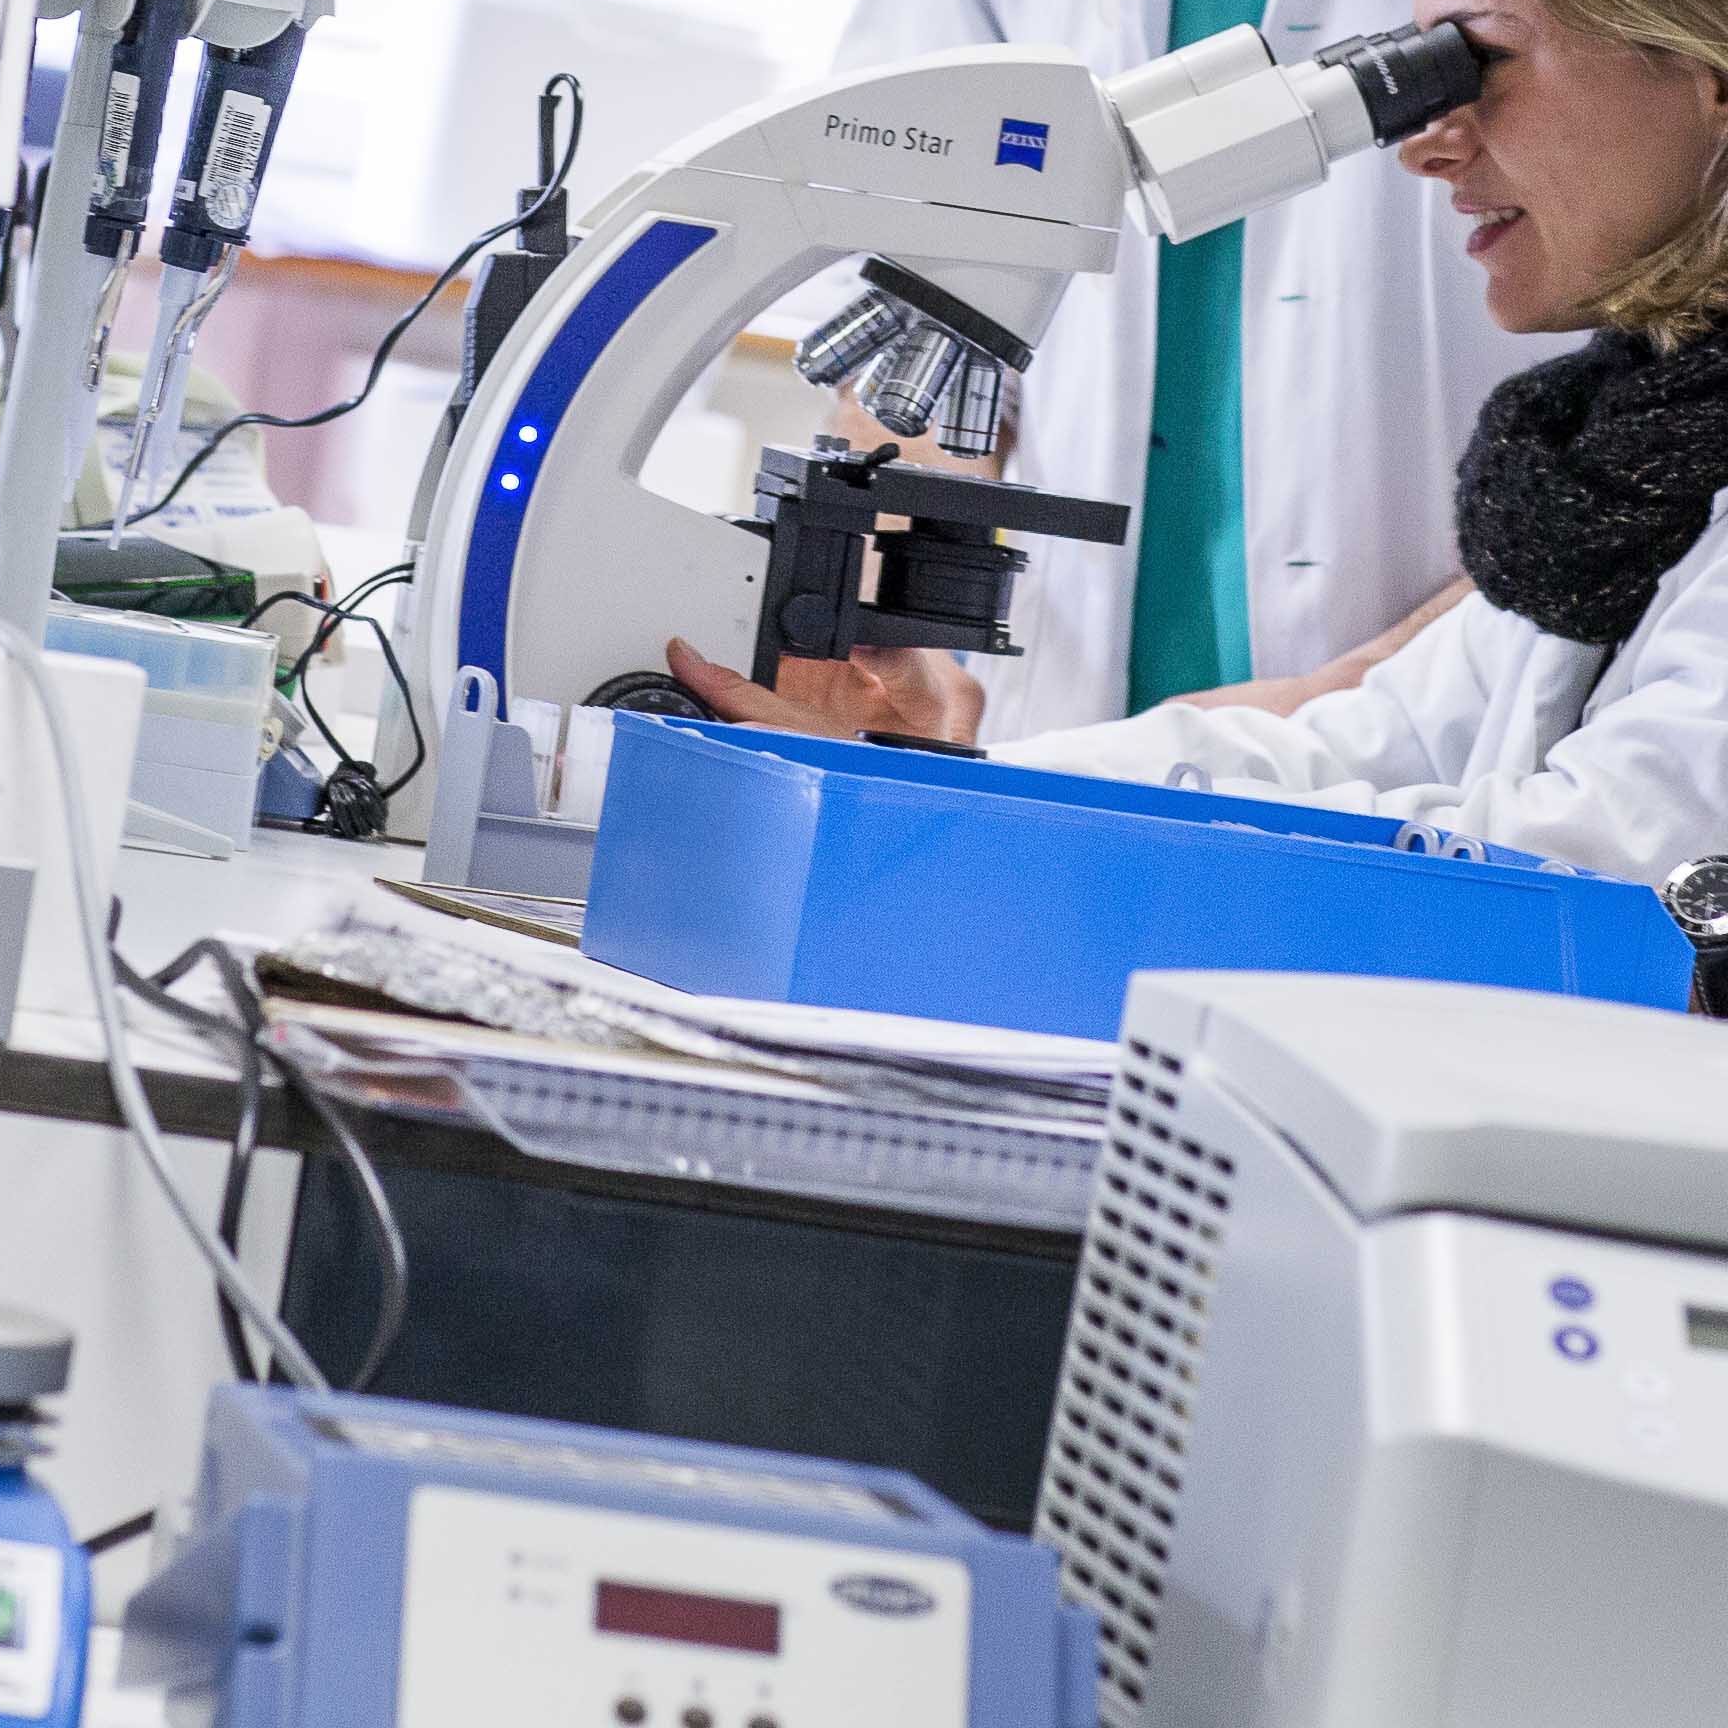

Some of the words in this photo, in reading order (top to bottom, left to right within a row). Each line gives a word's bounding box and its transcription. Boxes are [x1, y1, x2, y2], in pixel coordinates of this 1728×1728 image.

[824, 113, 897, 147] Primo
[903, 127, 954, 156] Star
[1000, 132, 1048, 150] ZEISS
